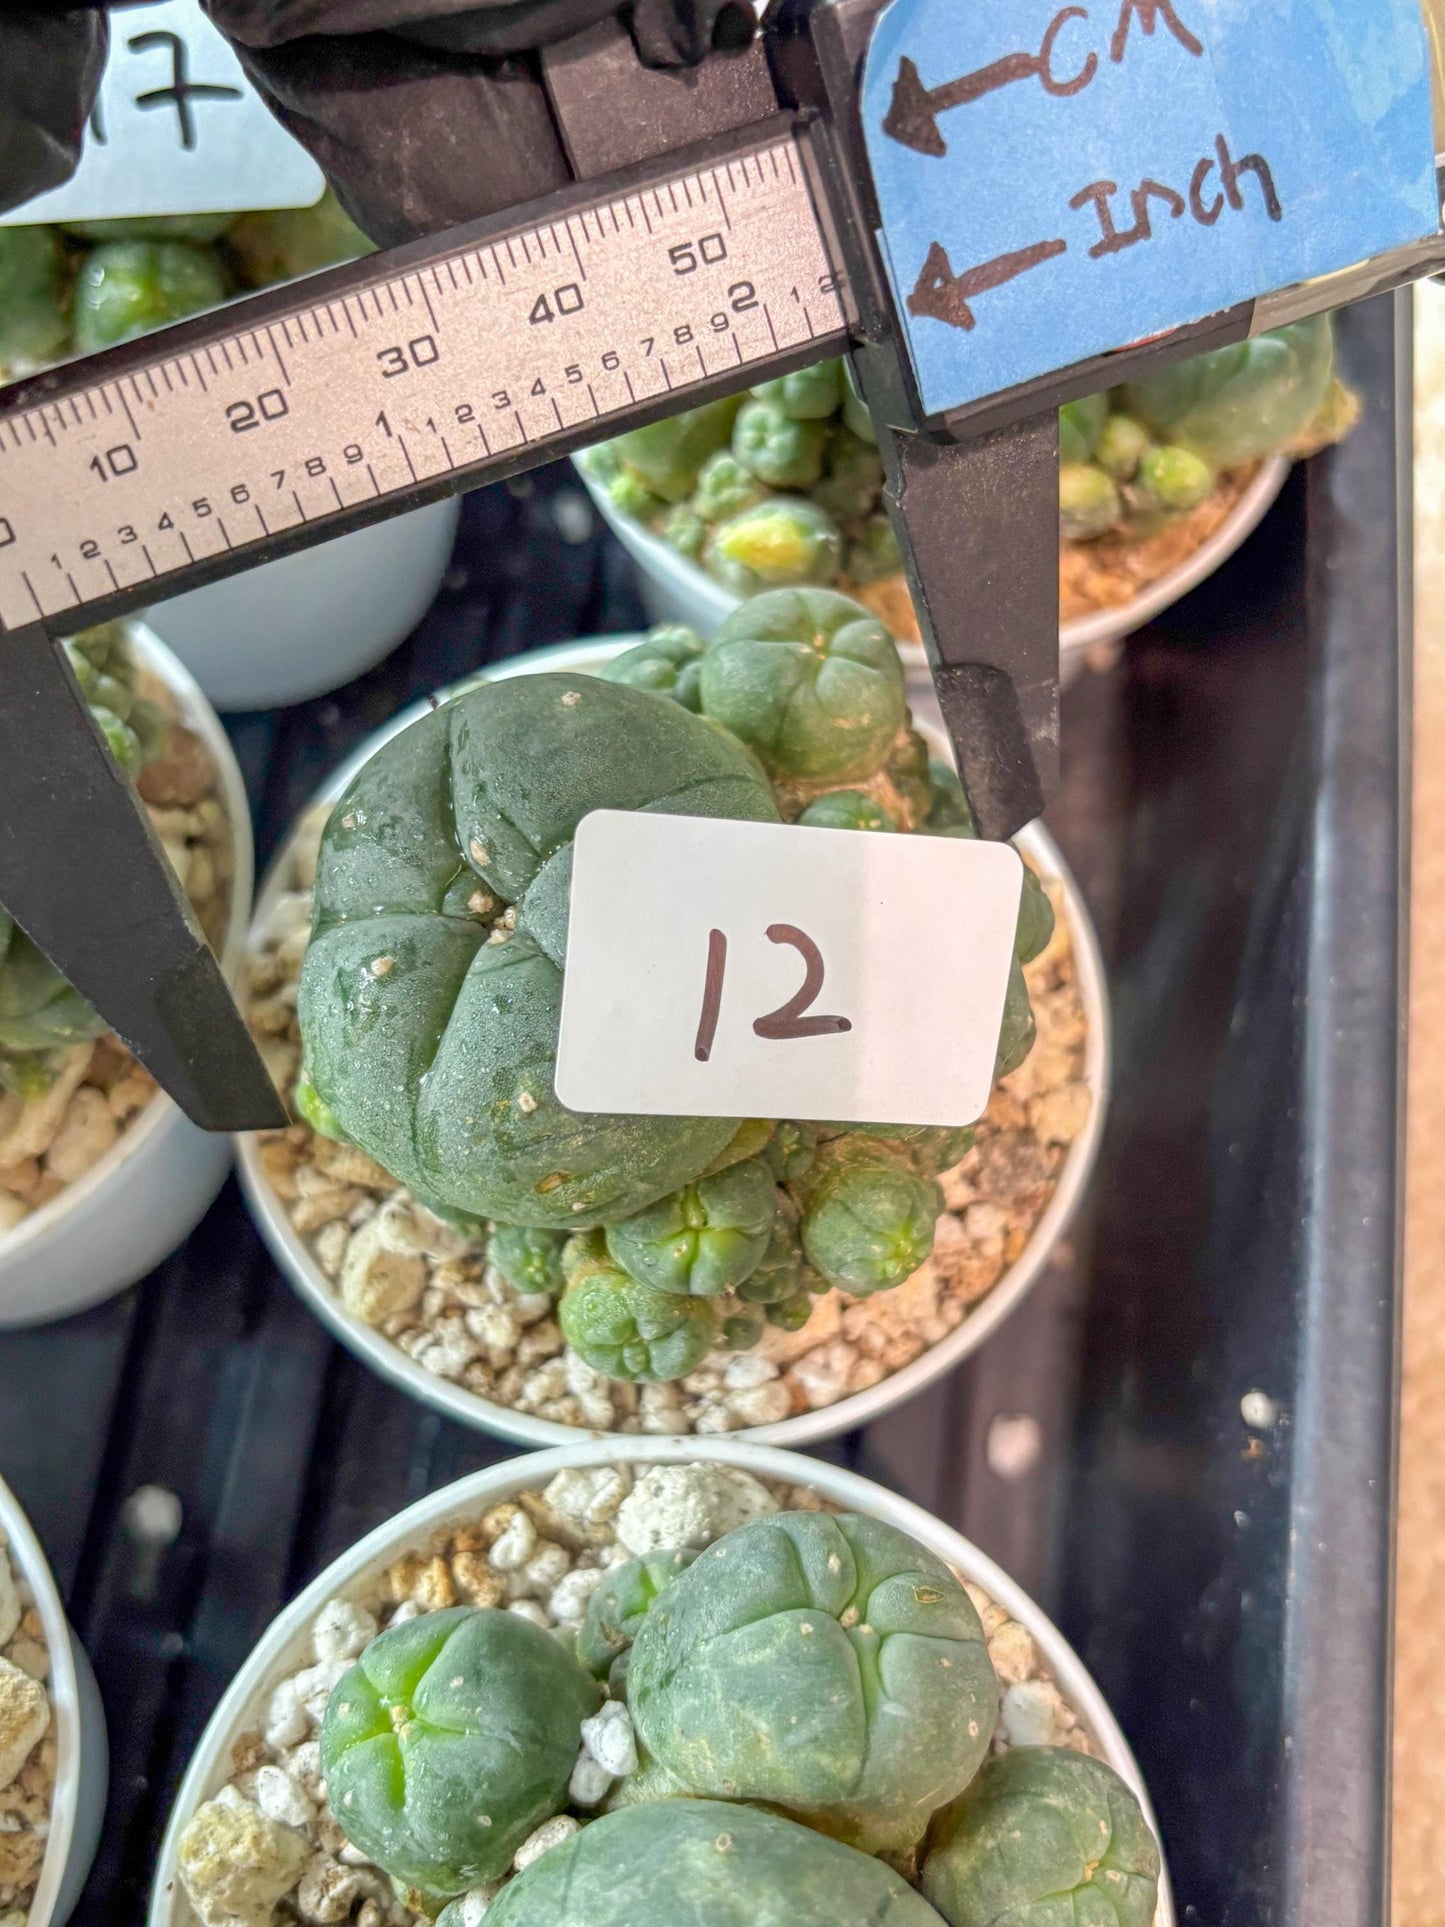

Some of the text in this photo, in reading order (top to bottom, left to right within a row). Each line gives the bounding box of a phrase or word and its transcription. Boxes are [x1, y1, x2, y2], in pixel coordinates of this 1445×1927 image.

[1039, 0, 1203, 97] CM
[1069, 134, 1282, 259] Inch
[50, 553, 62, 570] 1
[80, 540, 102, 559] 2
[117, 525, 138, 544] 3
[158, 512, 175, 531] 4
[193, 497, 213, 517] 5
[230, 484, 251, 504] 6
[270, 470, 286, 490] 7
[304, 456, 327, 477] 8
[342, 444, 364, 464] 9
[375, 410, 393, 438] 1
[426, 417, 438, 434] 1
[454, 403, 476, 424] 2
[491, 390, 512, 410] 3
[530, 377, 547, 397] 4
[564, 364, 584, 385] 5
[600, 351, 621, 371] 6
[640, 337, 655, 357] 7
[672, 324, 695, 346] 8
[709, 312, 730, 333] 9
[727, 280, 759, 313] 2
[789, 286, 800, 304] 1
[89, 443, 138, 482] 10
[225, 388, 290, 433] 20
[376, 334, 440, 379] 30
[529, 283, 585, 325] 40
[667, 232, 727, 275] 50
[694, 923, 852, 1062] 12
